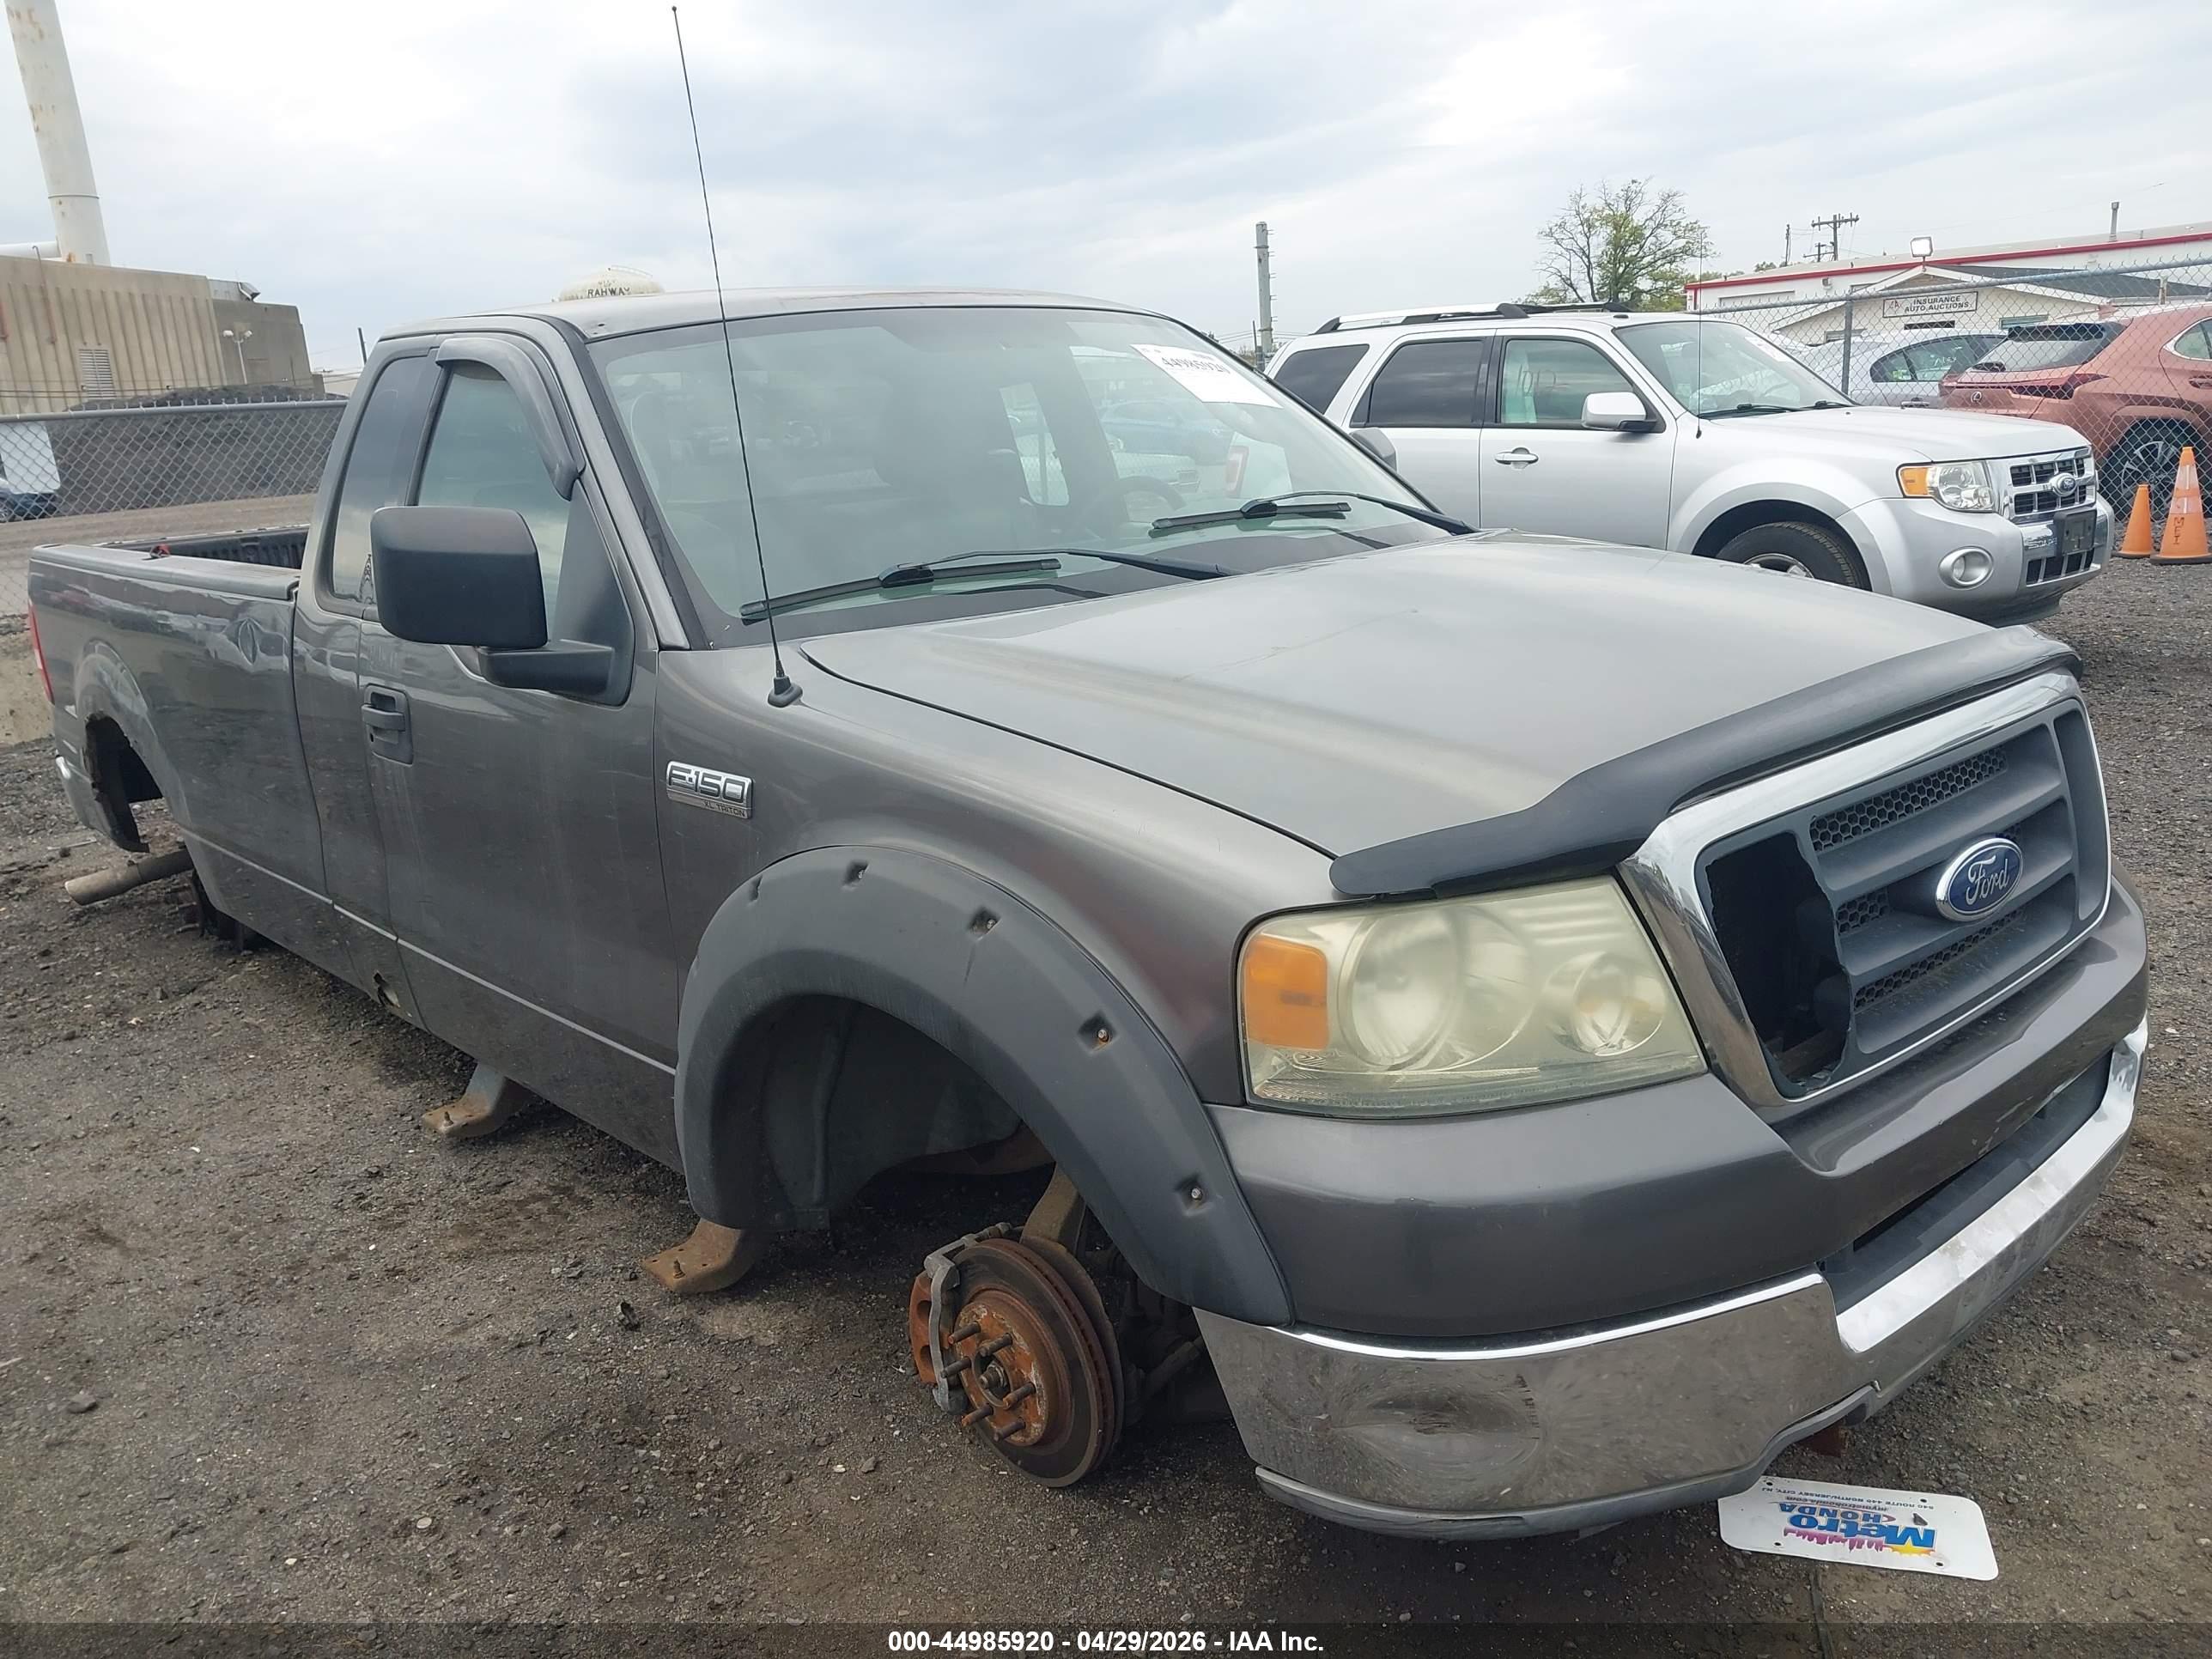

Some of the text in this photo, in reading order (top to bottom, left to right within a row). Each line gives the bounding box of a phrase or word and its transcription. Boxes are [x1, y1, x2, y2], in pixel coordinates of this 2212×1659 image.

[1913, 295, 1960, 305] INSURANCE
[1929, 301, 1969, 311] AUCTIONS
[1966, 854, 2008, 905] Ford
[1779, 1503, 1882, 1523] HONDA
[1790, 1514, 1936, 1548] Metro
